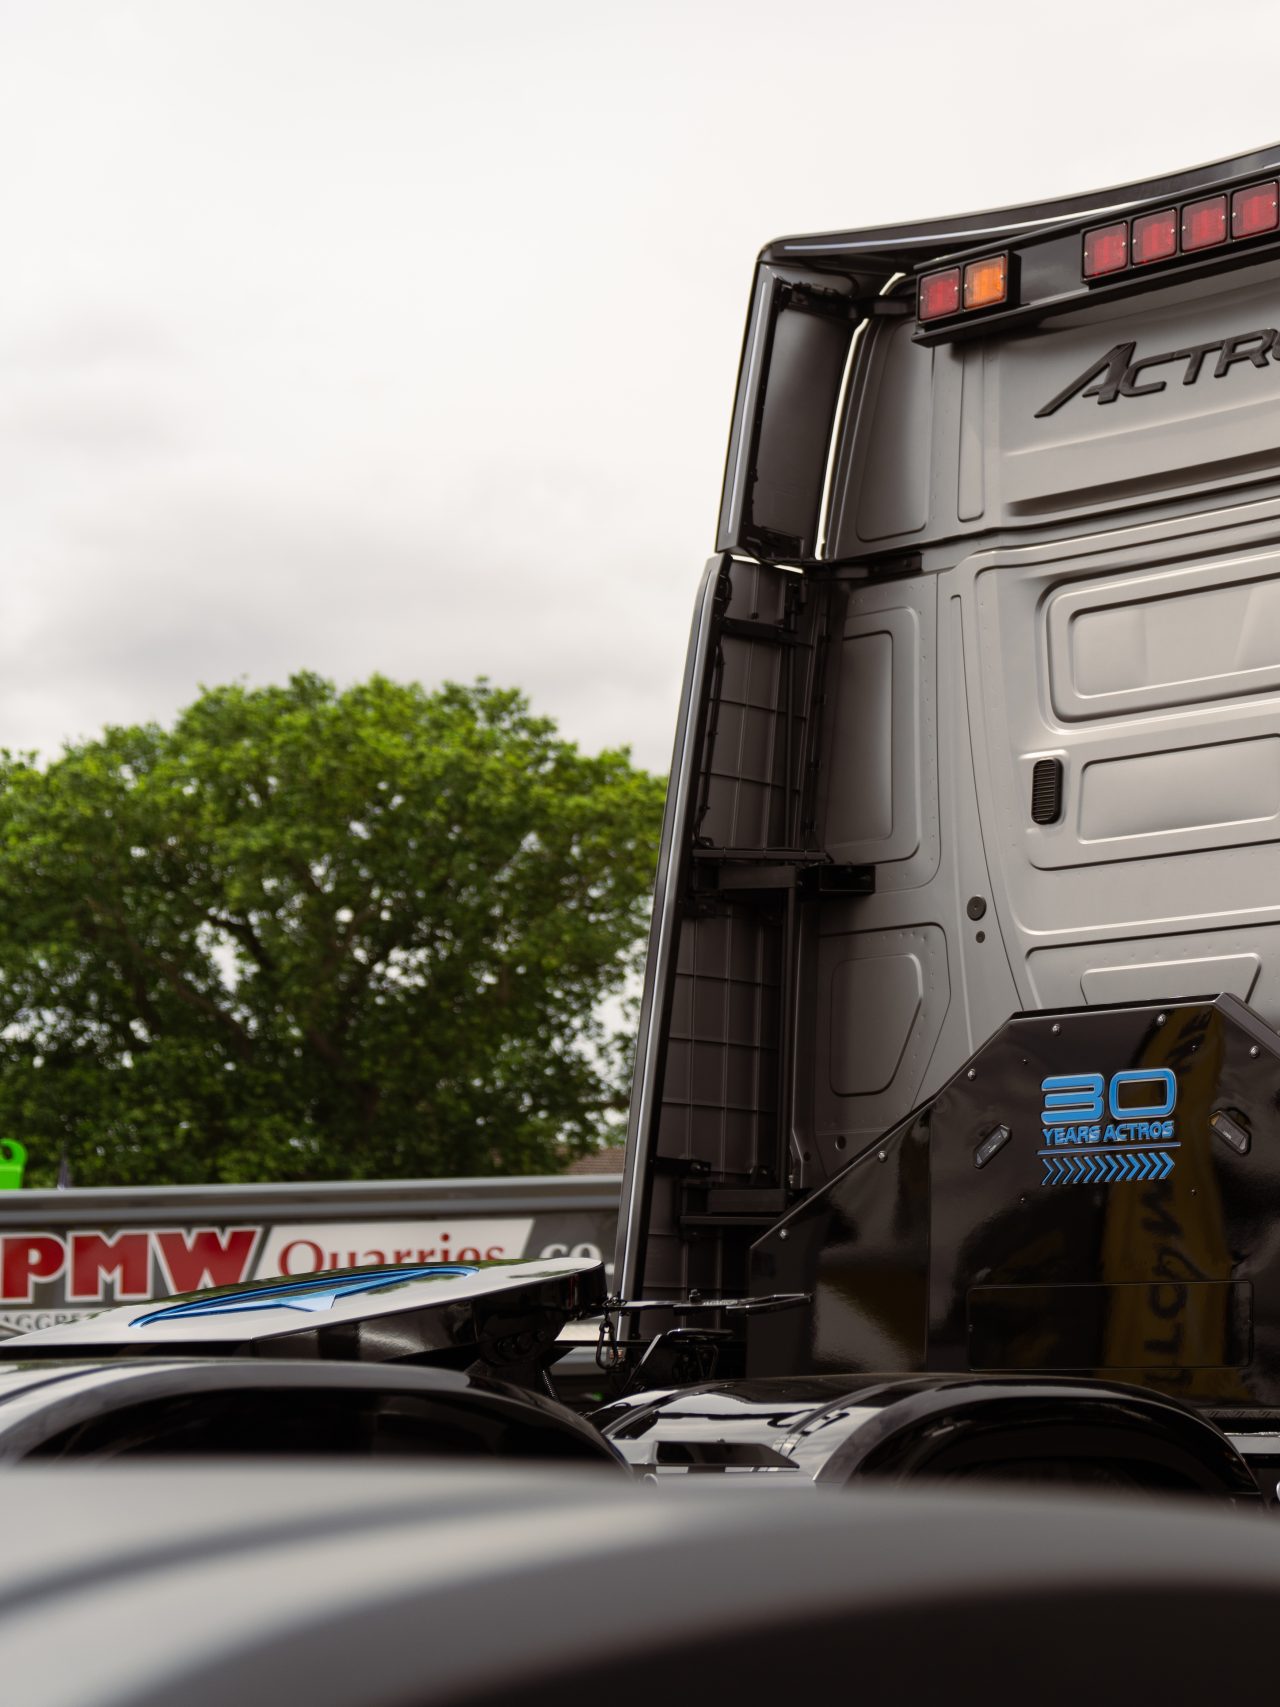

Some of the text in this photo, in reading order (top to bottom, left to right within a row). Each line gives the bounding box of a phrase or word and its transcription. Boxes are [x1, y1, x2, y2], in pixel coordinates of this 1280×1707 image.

[1041, 1068, 1177, 1125] 30
[1042, 1120, 1175, 1146] YEARS ACTROS
[0, 1228, 261, 1301] PMW
